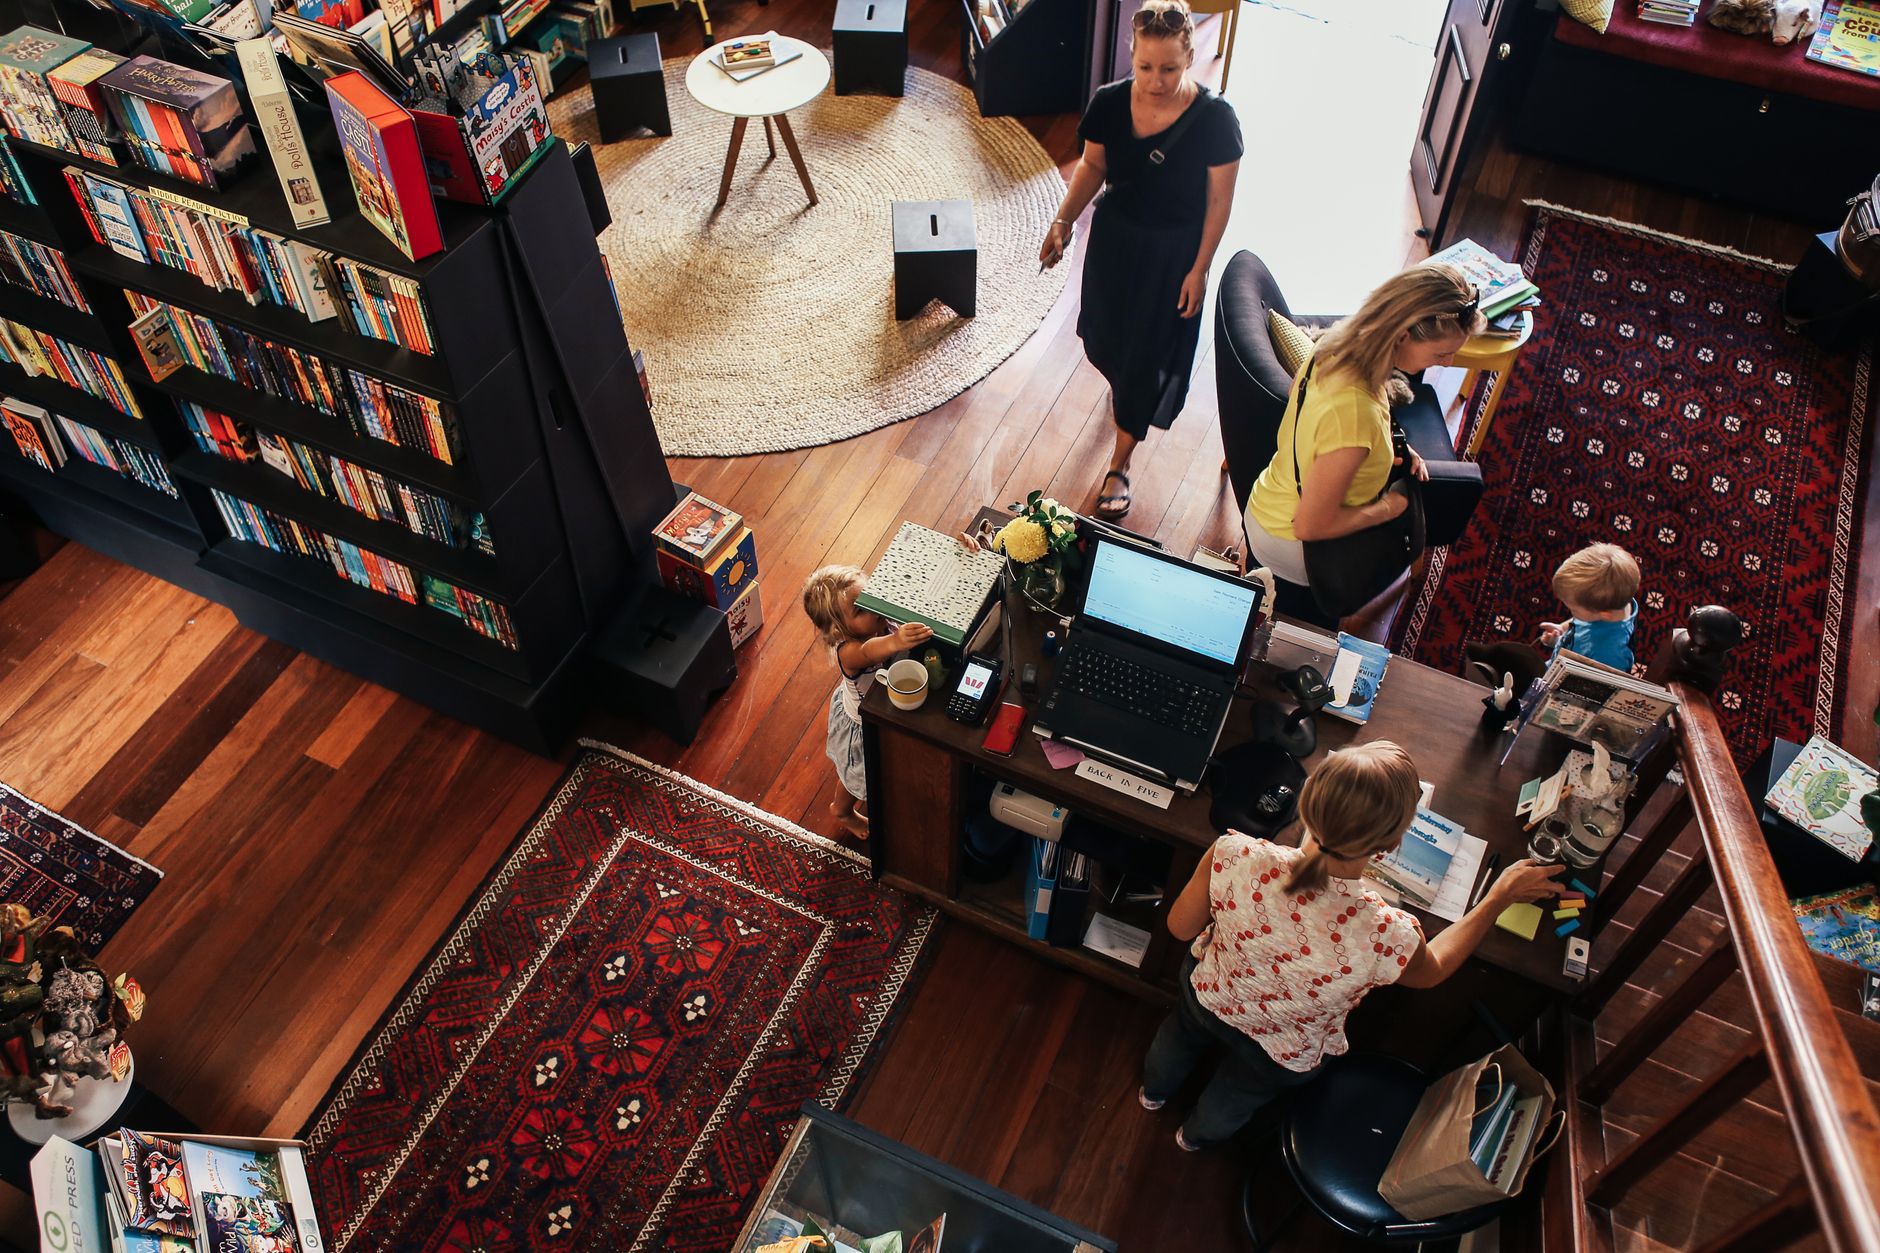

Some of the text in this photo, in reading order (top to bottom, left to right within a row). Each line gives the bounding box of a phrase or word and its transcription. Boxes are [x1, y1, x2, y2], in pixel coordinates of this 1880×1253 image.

[1841, 28, 1868, 40] from
[16, 42, 57, 60] GATES
[129, 68, 161, 84] HARRY
[160, 76, 197, 93] POTTER
[275, 105, 304, 170] Dolls House
[475, 93, 536, 155] Maisy's Castle
[150, 188, 248, 225] MIDDLE READER FICTION
[666, 511, 692, 536] Maisy's
[1087, 766, 1160, 799] BACK IN FIVE
[1829, 921, 1874, 951] Garden
[64, 1155, 78, 1208] PRESS
